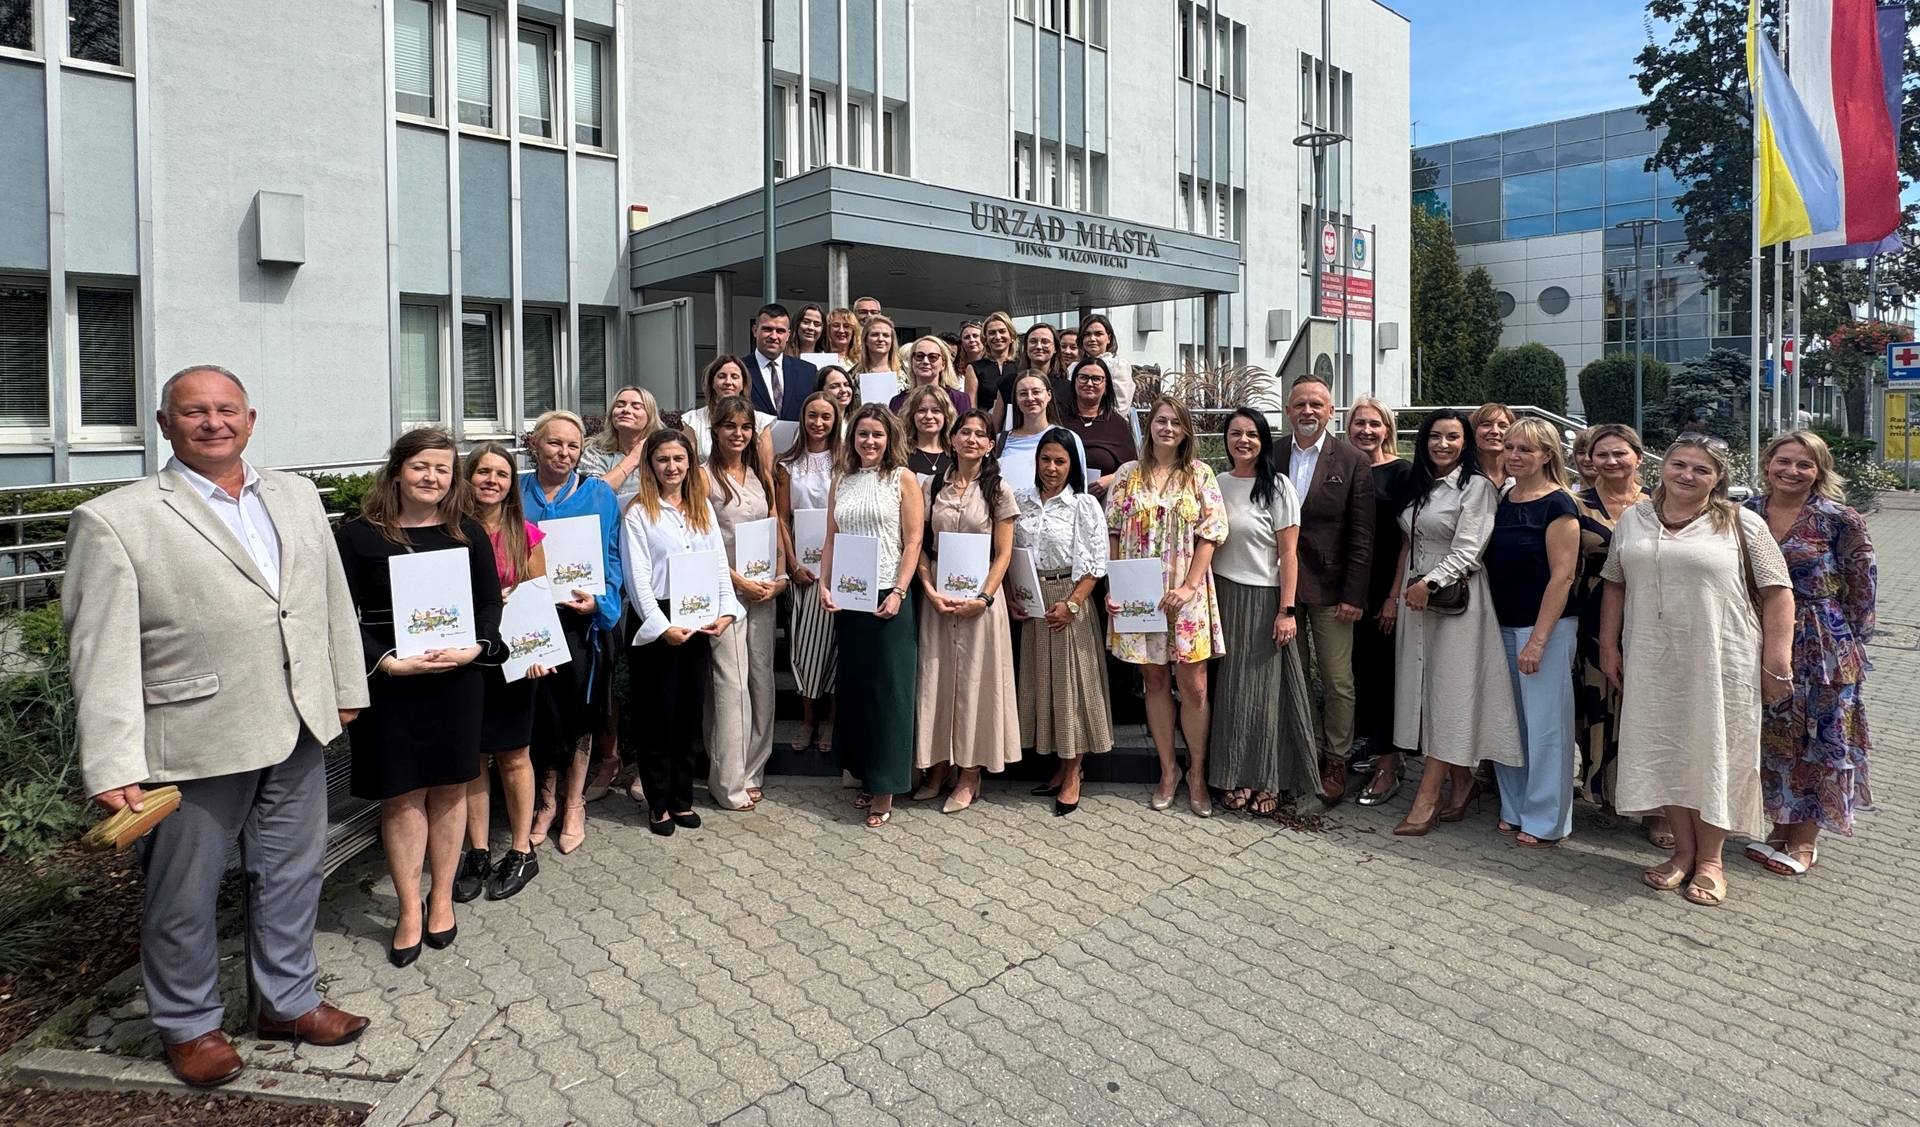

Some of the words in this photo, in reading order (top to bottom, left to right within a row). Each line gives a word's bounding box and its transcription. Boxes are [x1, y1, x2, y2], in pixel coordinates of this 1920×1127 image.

[970, 201, 1065, 244] URZĄD
[1076, 221, 1161, 258] MIASTA
[1014, 241, 1052, 259] MIŃSK
[1058, 248, 1128, 269] MAZOWIECKI
